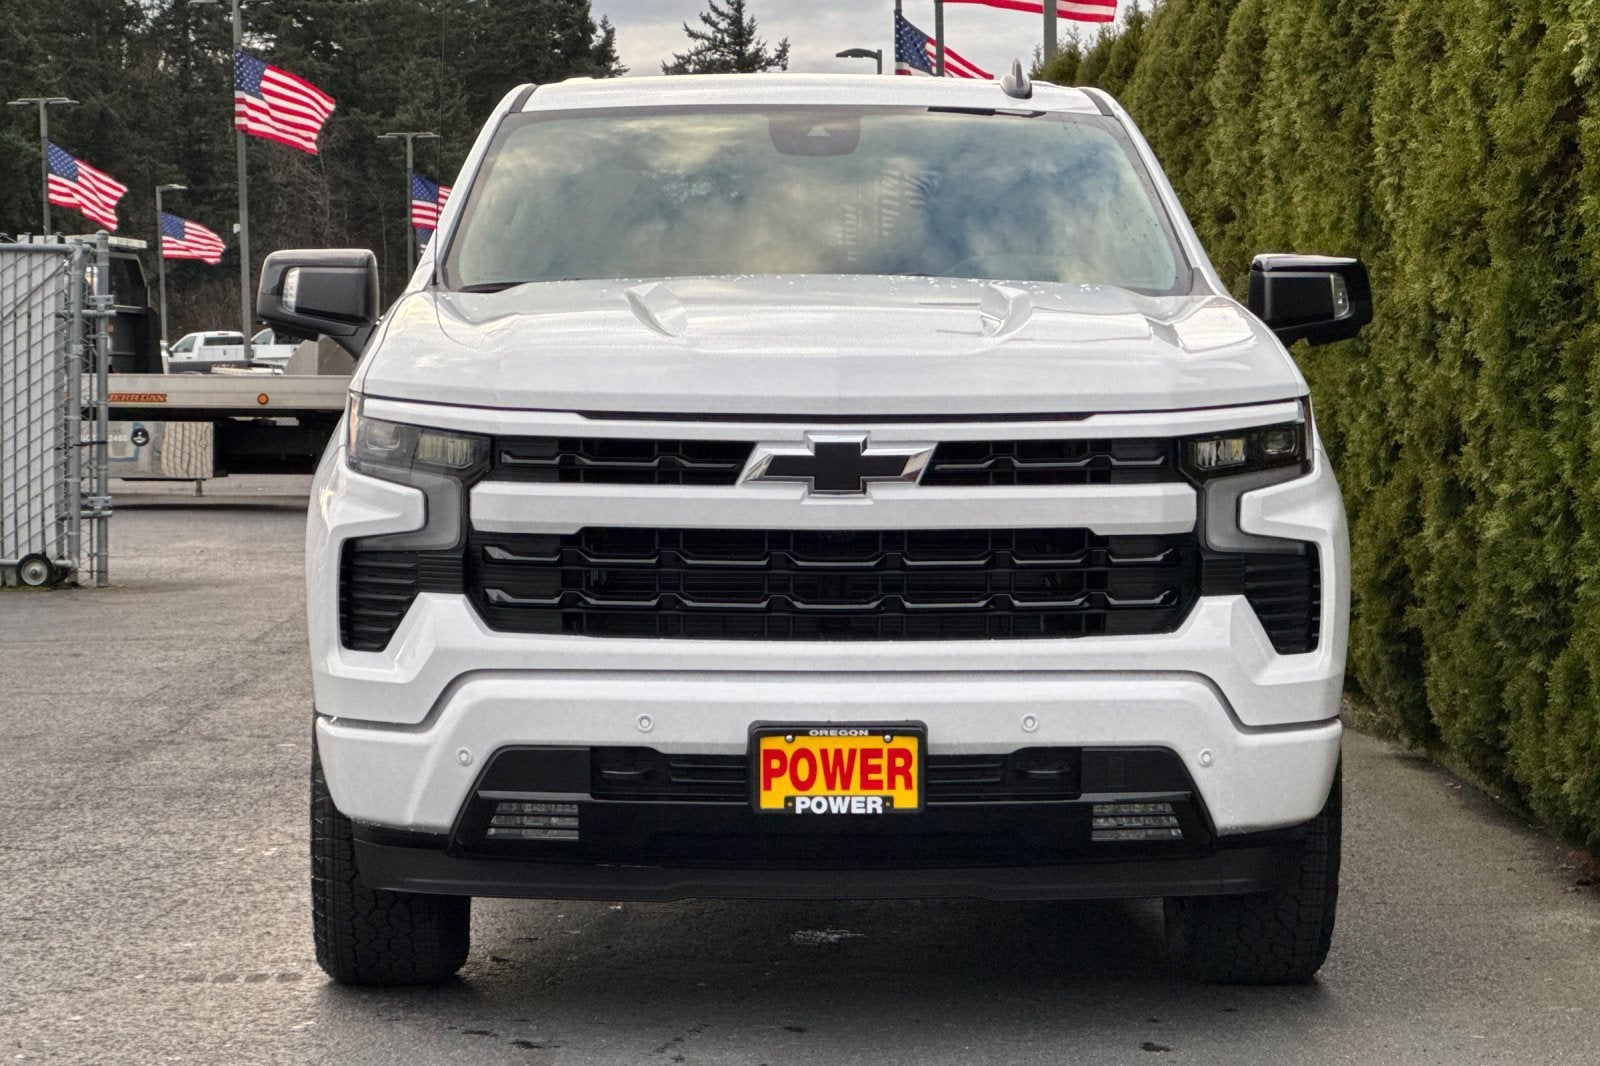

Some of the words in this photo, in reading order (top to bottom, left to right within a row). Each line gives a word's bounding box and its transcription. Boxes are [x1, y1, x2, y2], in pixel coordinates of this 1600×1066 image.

[808, 729, 869, 737] OREGON
[762, 747, 913, 792] POWER
[795, 796, 883, 814] POWER
